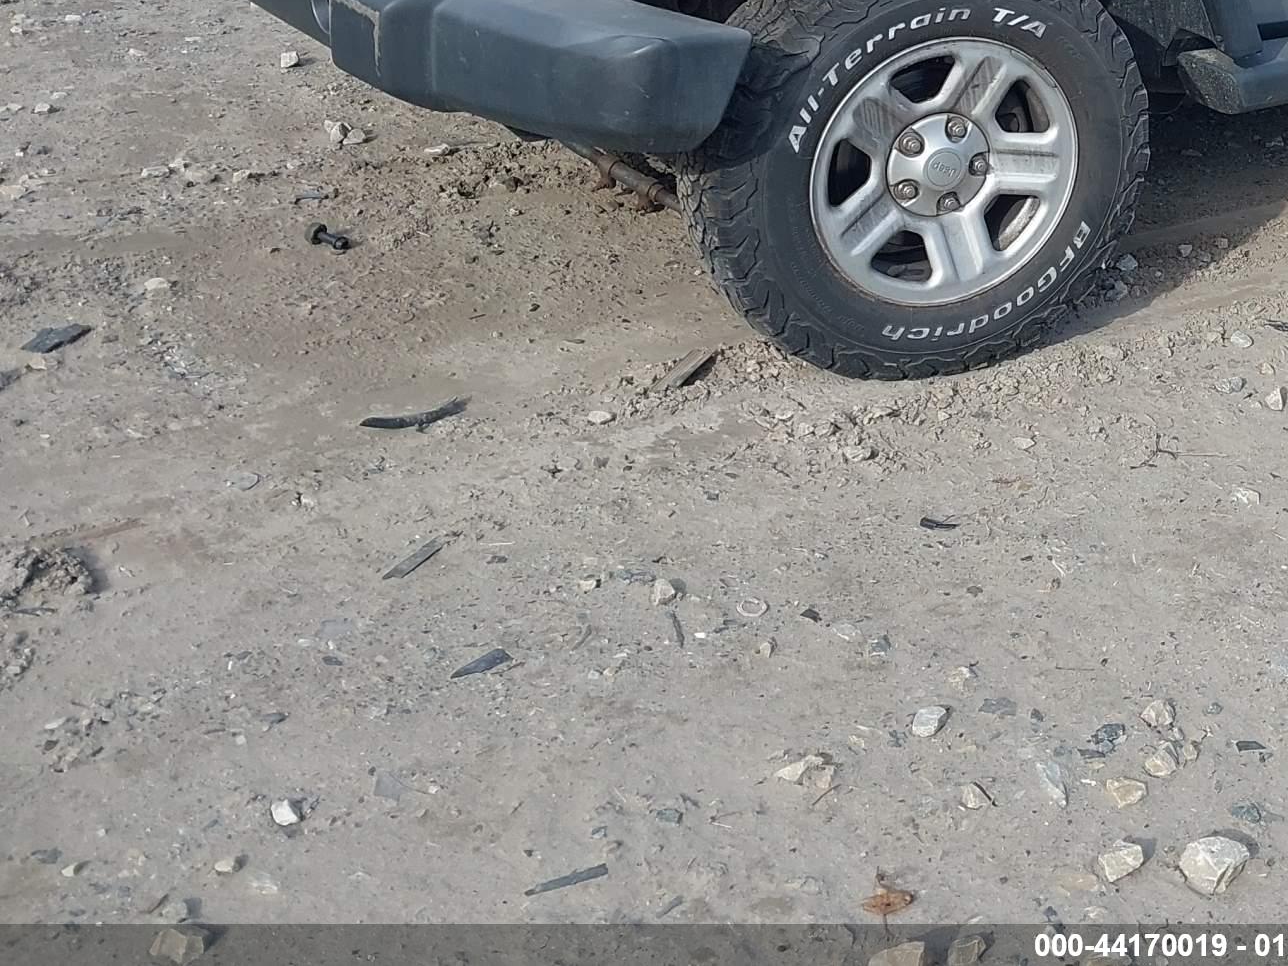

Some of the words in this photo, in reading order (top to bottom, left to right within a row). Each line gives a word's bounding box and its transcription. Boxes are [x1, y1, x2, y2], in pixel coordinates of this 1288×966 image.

[788, 7, 972, 154] All-Terrain
[992, 7, 1049, 39] T/A
[881, 220, 1092, 341] BFGoodrich
